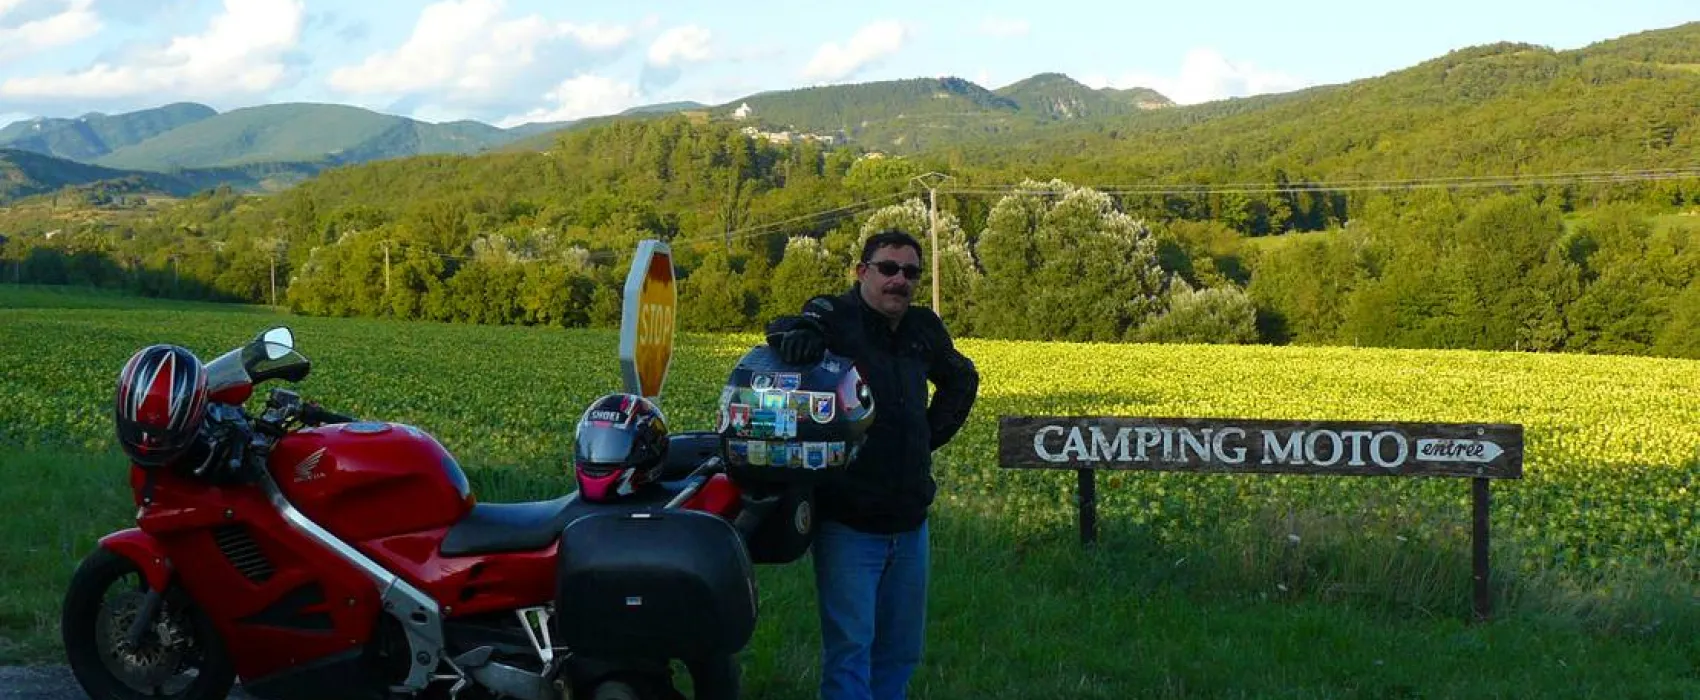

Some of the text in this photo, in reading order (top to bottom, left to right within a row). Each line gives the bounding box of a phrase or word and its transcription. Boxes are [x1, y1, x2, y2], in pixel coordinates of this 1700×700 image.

[640, 303, 672, 345] STOP
[592, 411, 620, 421] SHOEI
[1033, 424, 1408, 468] CAMPING MOTO
